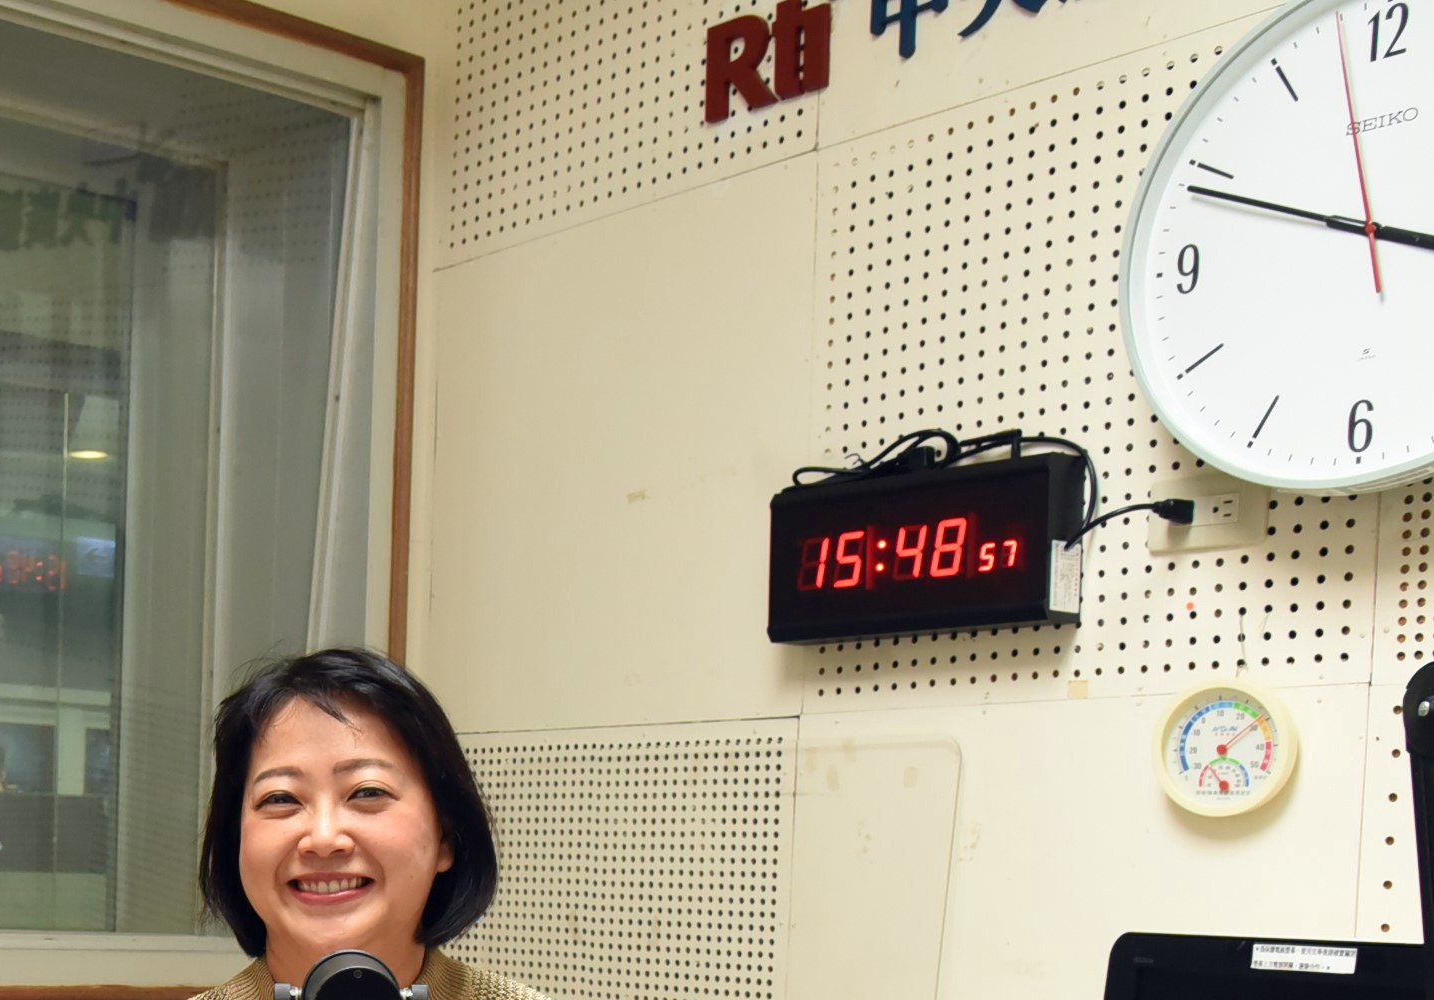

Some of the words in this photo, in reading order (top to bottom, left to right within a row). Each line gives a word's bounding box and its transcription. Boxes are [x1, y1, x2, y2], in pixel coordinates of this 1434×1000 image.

[1367, 2, 1409, 62] 12
[1345, 107, 1419, 136] SEIKO
[1176, 243, 1200, 294] 9
[1348, 399, 1374, 453] 6
[815, 517, 968, 589] 15:48
[978, 540, 1017, 573] 57
